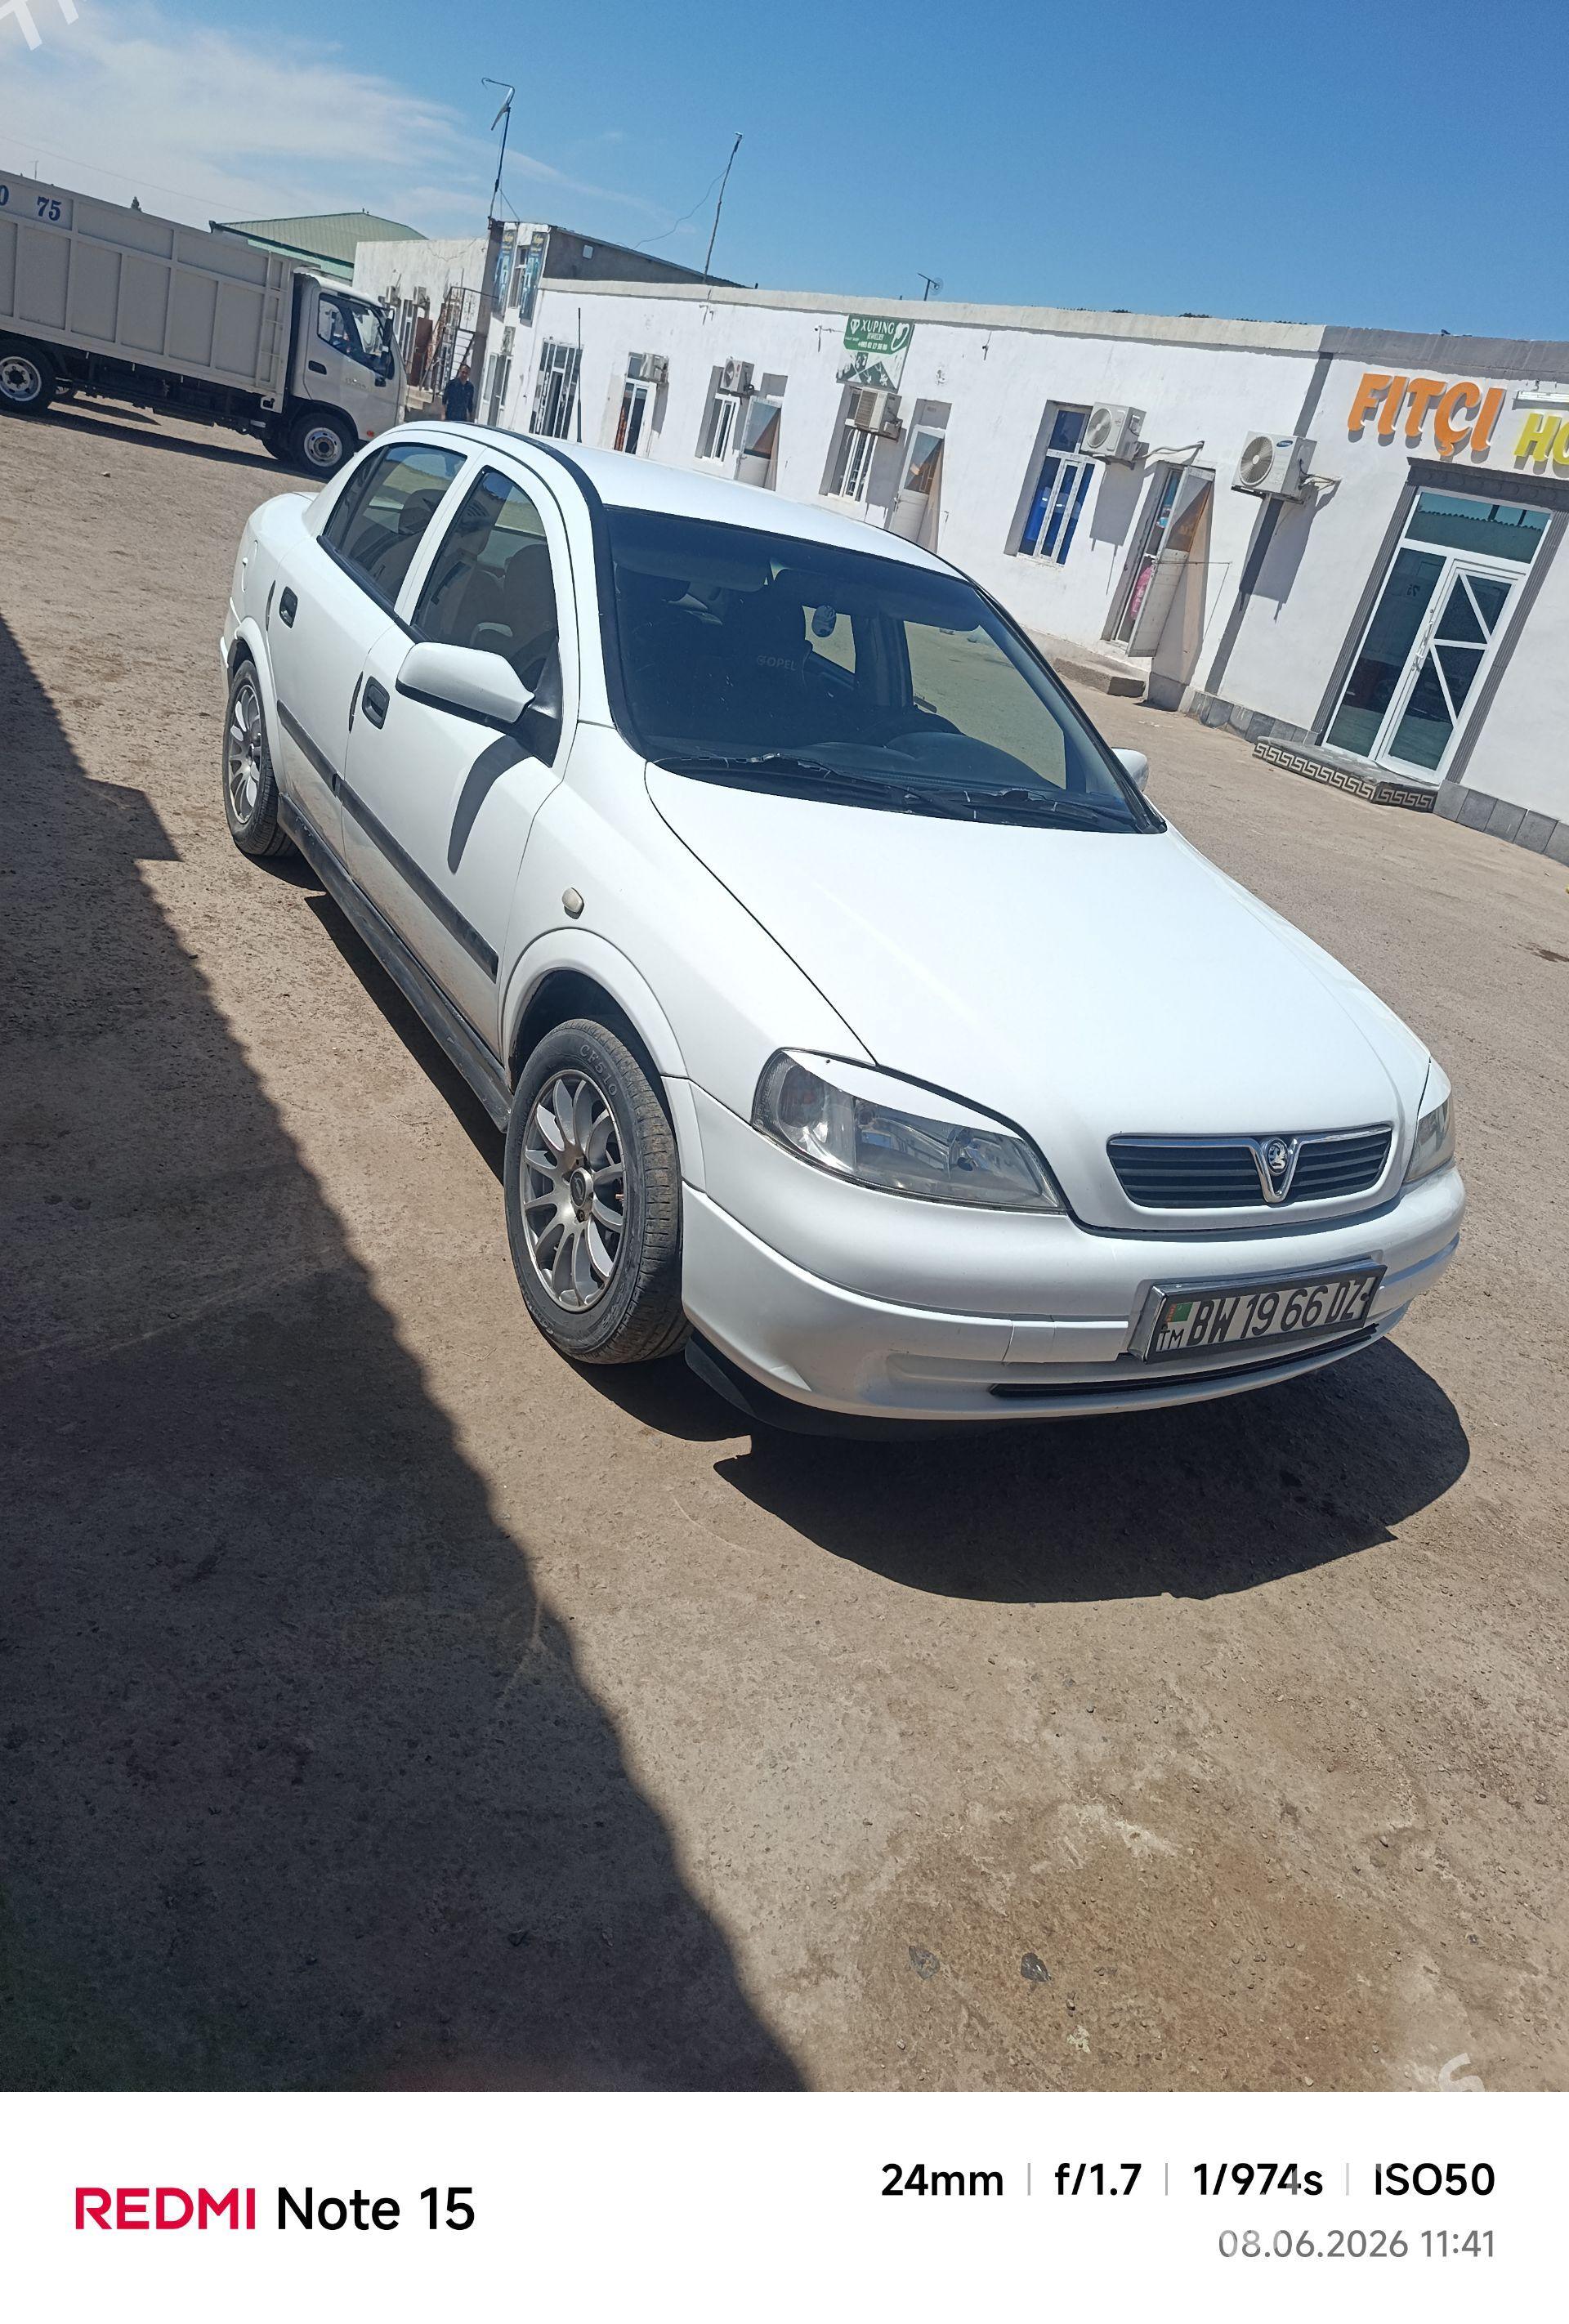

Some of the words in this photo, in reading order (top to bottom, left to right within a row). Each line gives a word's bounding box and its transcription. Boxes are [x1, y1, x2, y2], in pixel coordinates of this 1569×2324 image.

[37, 196, 61, 221] 75
[860, 320, 895, 335] XUPING
[1348, 373, 1506, 456] FITÇI
[767, 656, 796, 671] OPEL
[580, 1044, 617, 1096] CF510
[1187, 1297, 1240, 1346] BW
[1240, 1293, 1280, 1339] 19
[1281, 1285, 1328, 1332] 66
[1325, 1280, 1366, 1323] DZ
[1160, 1330, 1184, 1349] TM
